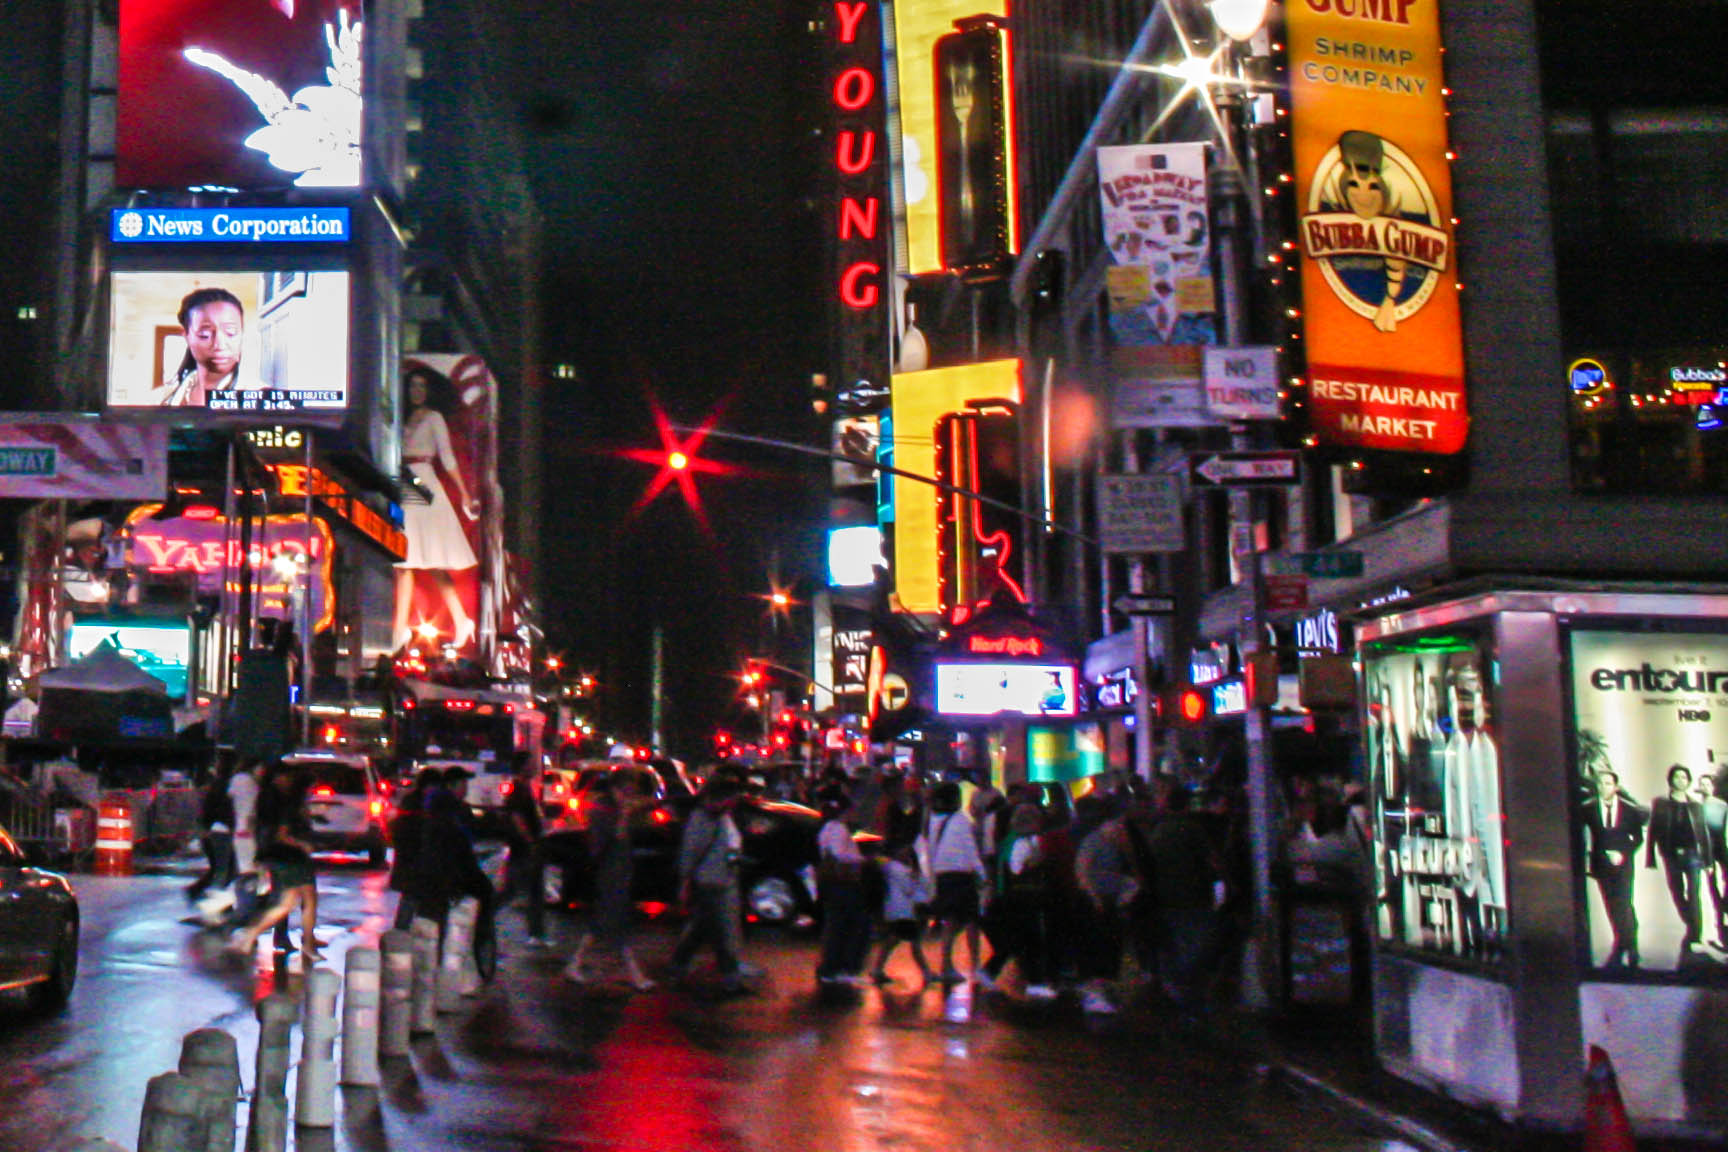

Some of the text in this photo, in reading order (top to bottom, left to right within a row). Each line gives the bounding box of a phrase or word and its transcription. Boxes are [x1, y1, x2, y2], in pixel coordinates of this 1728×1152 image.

[1315, 37, 1415, 68] SHRIMP
[1303, 61, 1428, 98] COMPANY
[832, 0, 881, 311] YOUNG
[147, 213, 343, 241] News Corporation
[1307, 219, 1445, 264] BUBBA GUMP
[1223, 358, 1256, 378] NO
[1312, 377, 1460, 412] RESTAURANT
[1340, 411, 1437, 442] MARKET
